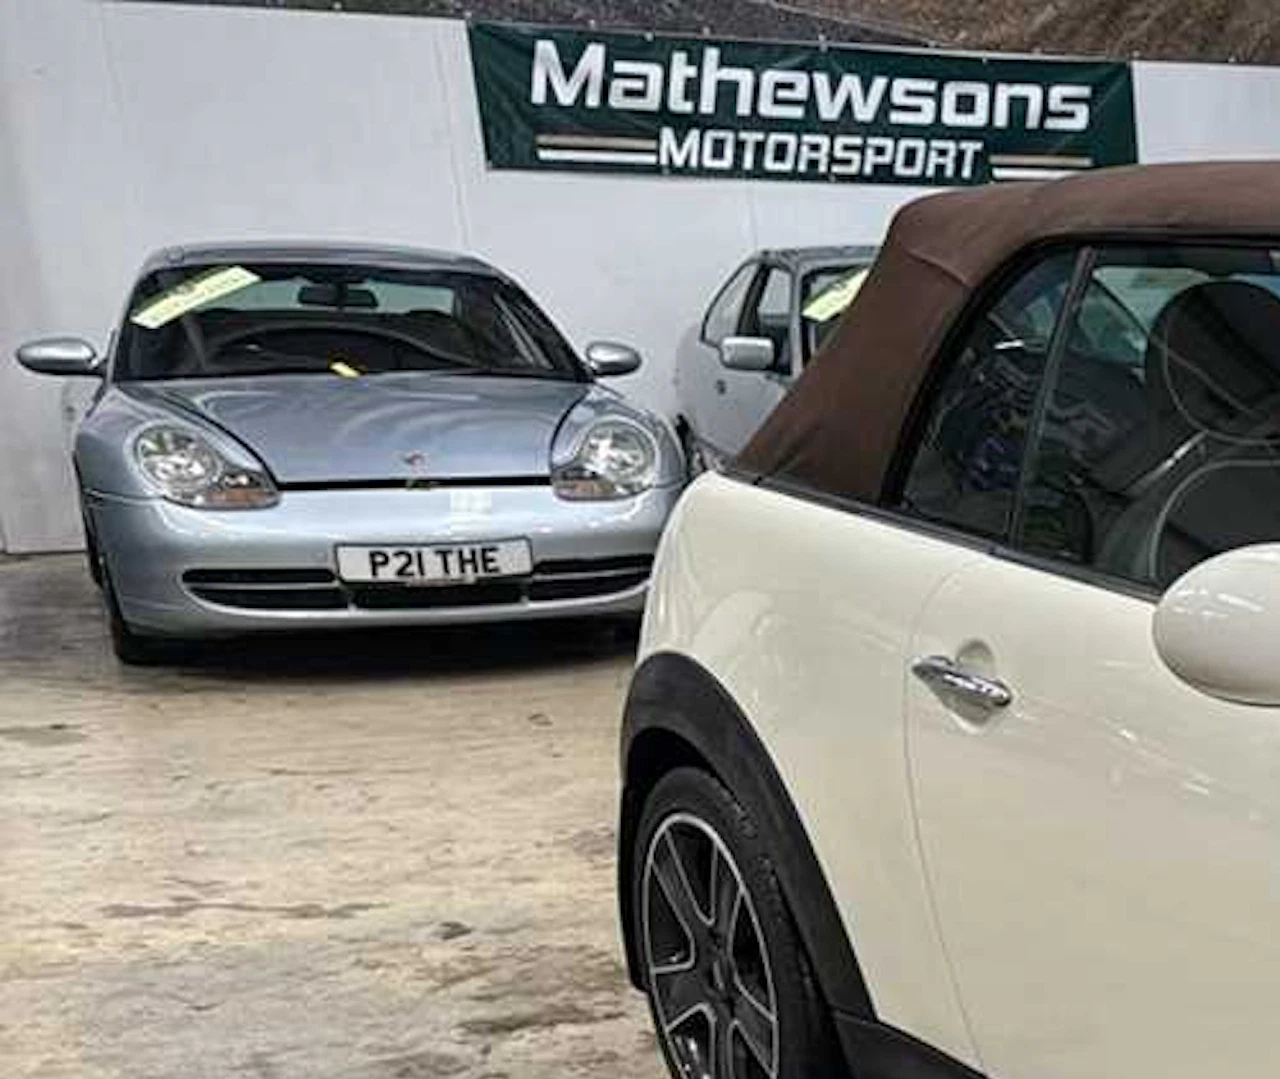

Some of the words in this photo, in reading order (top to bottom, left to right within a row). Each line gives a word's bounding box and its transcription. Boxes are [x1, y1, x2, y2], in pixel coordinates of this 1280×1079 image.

[530, 39, 1092, 131] Mathewsons
[659, 126, 984, 179] MOTORSPORT
[368, 550, 425, 577] P21
[434, 547, 499, 574] THE
